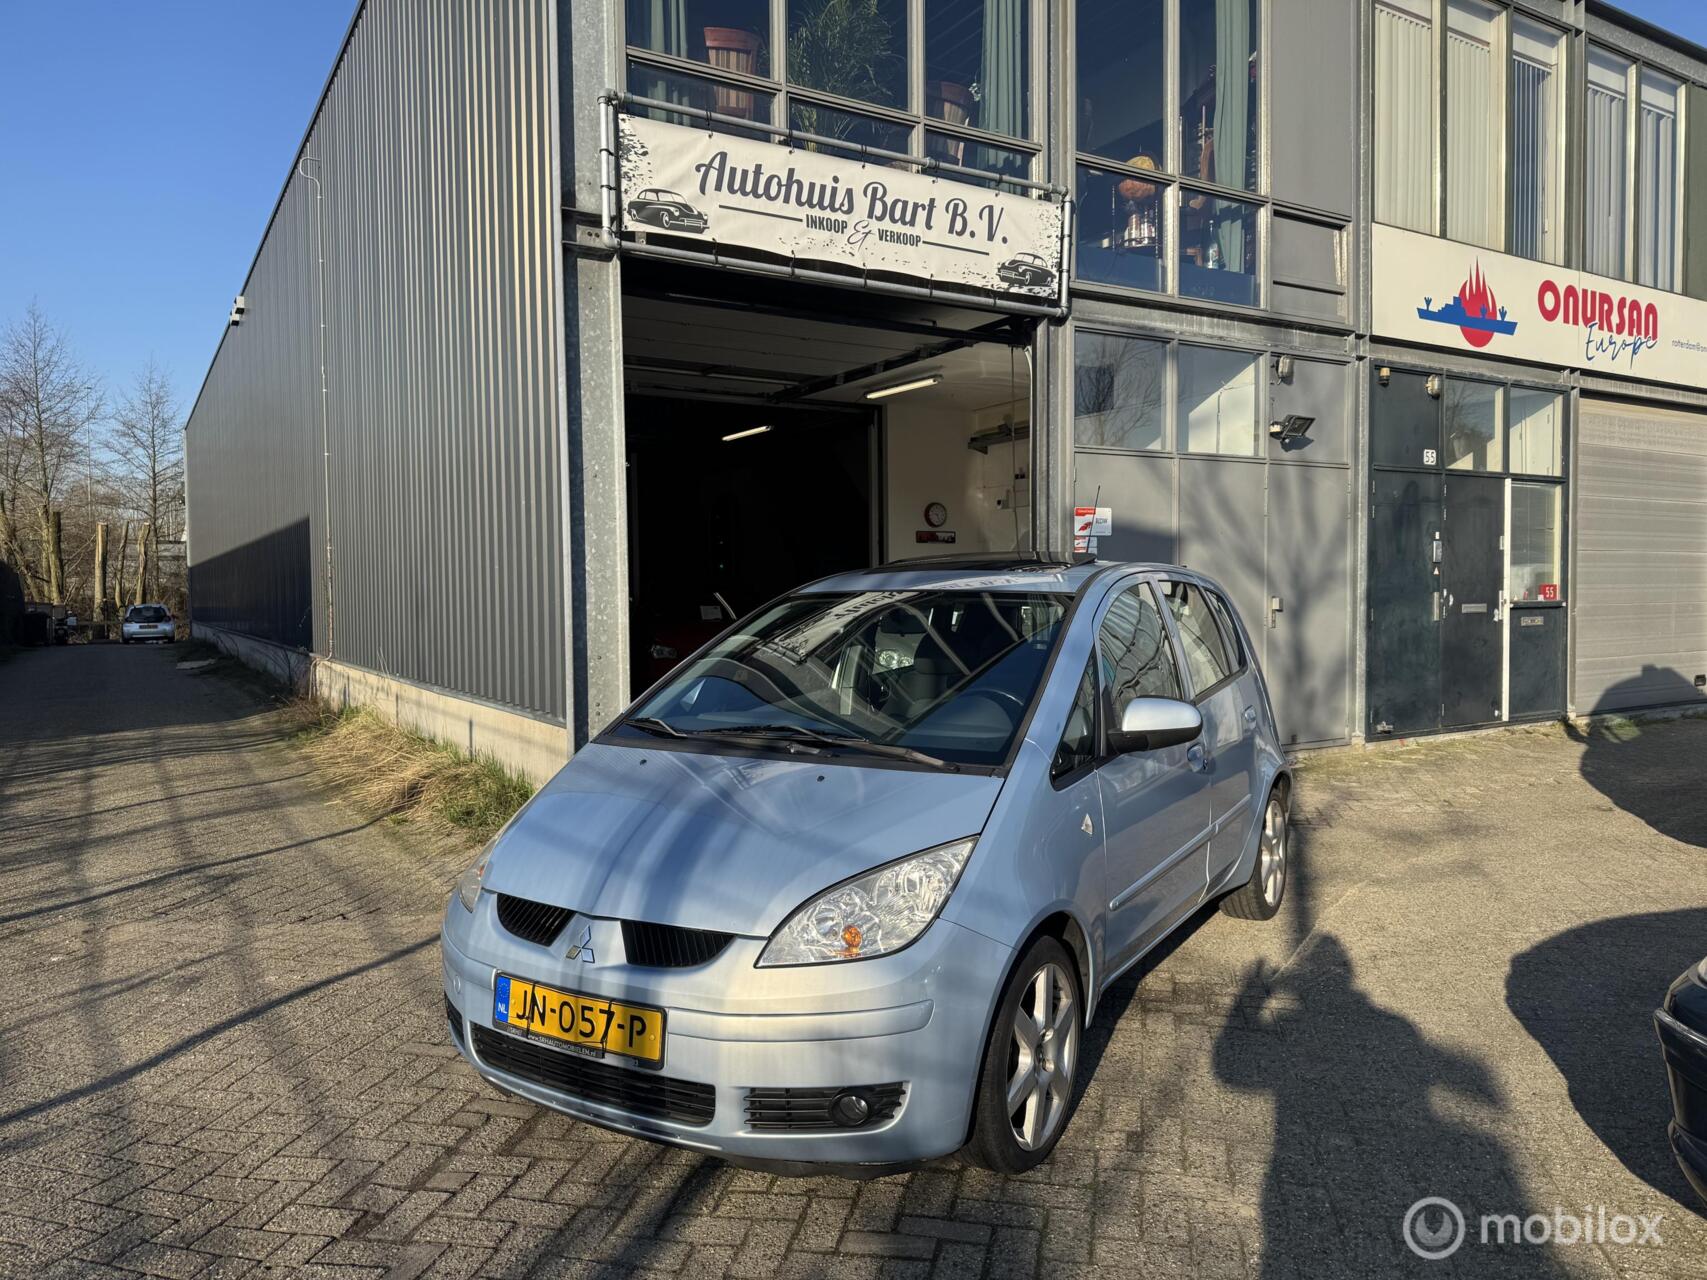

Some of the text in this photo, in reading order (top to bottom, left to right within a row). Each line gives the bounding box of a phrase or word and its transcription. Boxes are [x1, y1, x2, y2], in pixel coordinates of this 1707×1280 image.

[695, 151, 1009, 245] Autohuis Bart B.V.
[805, 214, 922, 250] INKOOP & VERKOOP
[1538, 280, 1658, 341] ONURSAN
[1585, 322, 1658, 370] Europe
[1425, 451, 1435, 464] 55
[1545, 586, 1554, 598] 55
[497, 1001, 508, 1014] NL
[516, 989, 647, 1048] JN-057-P
